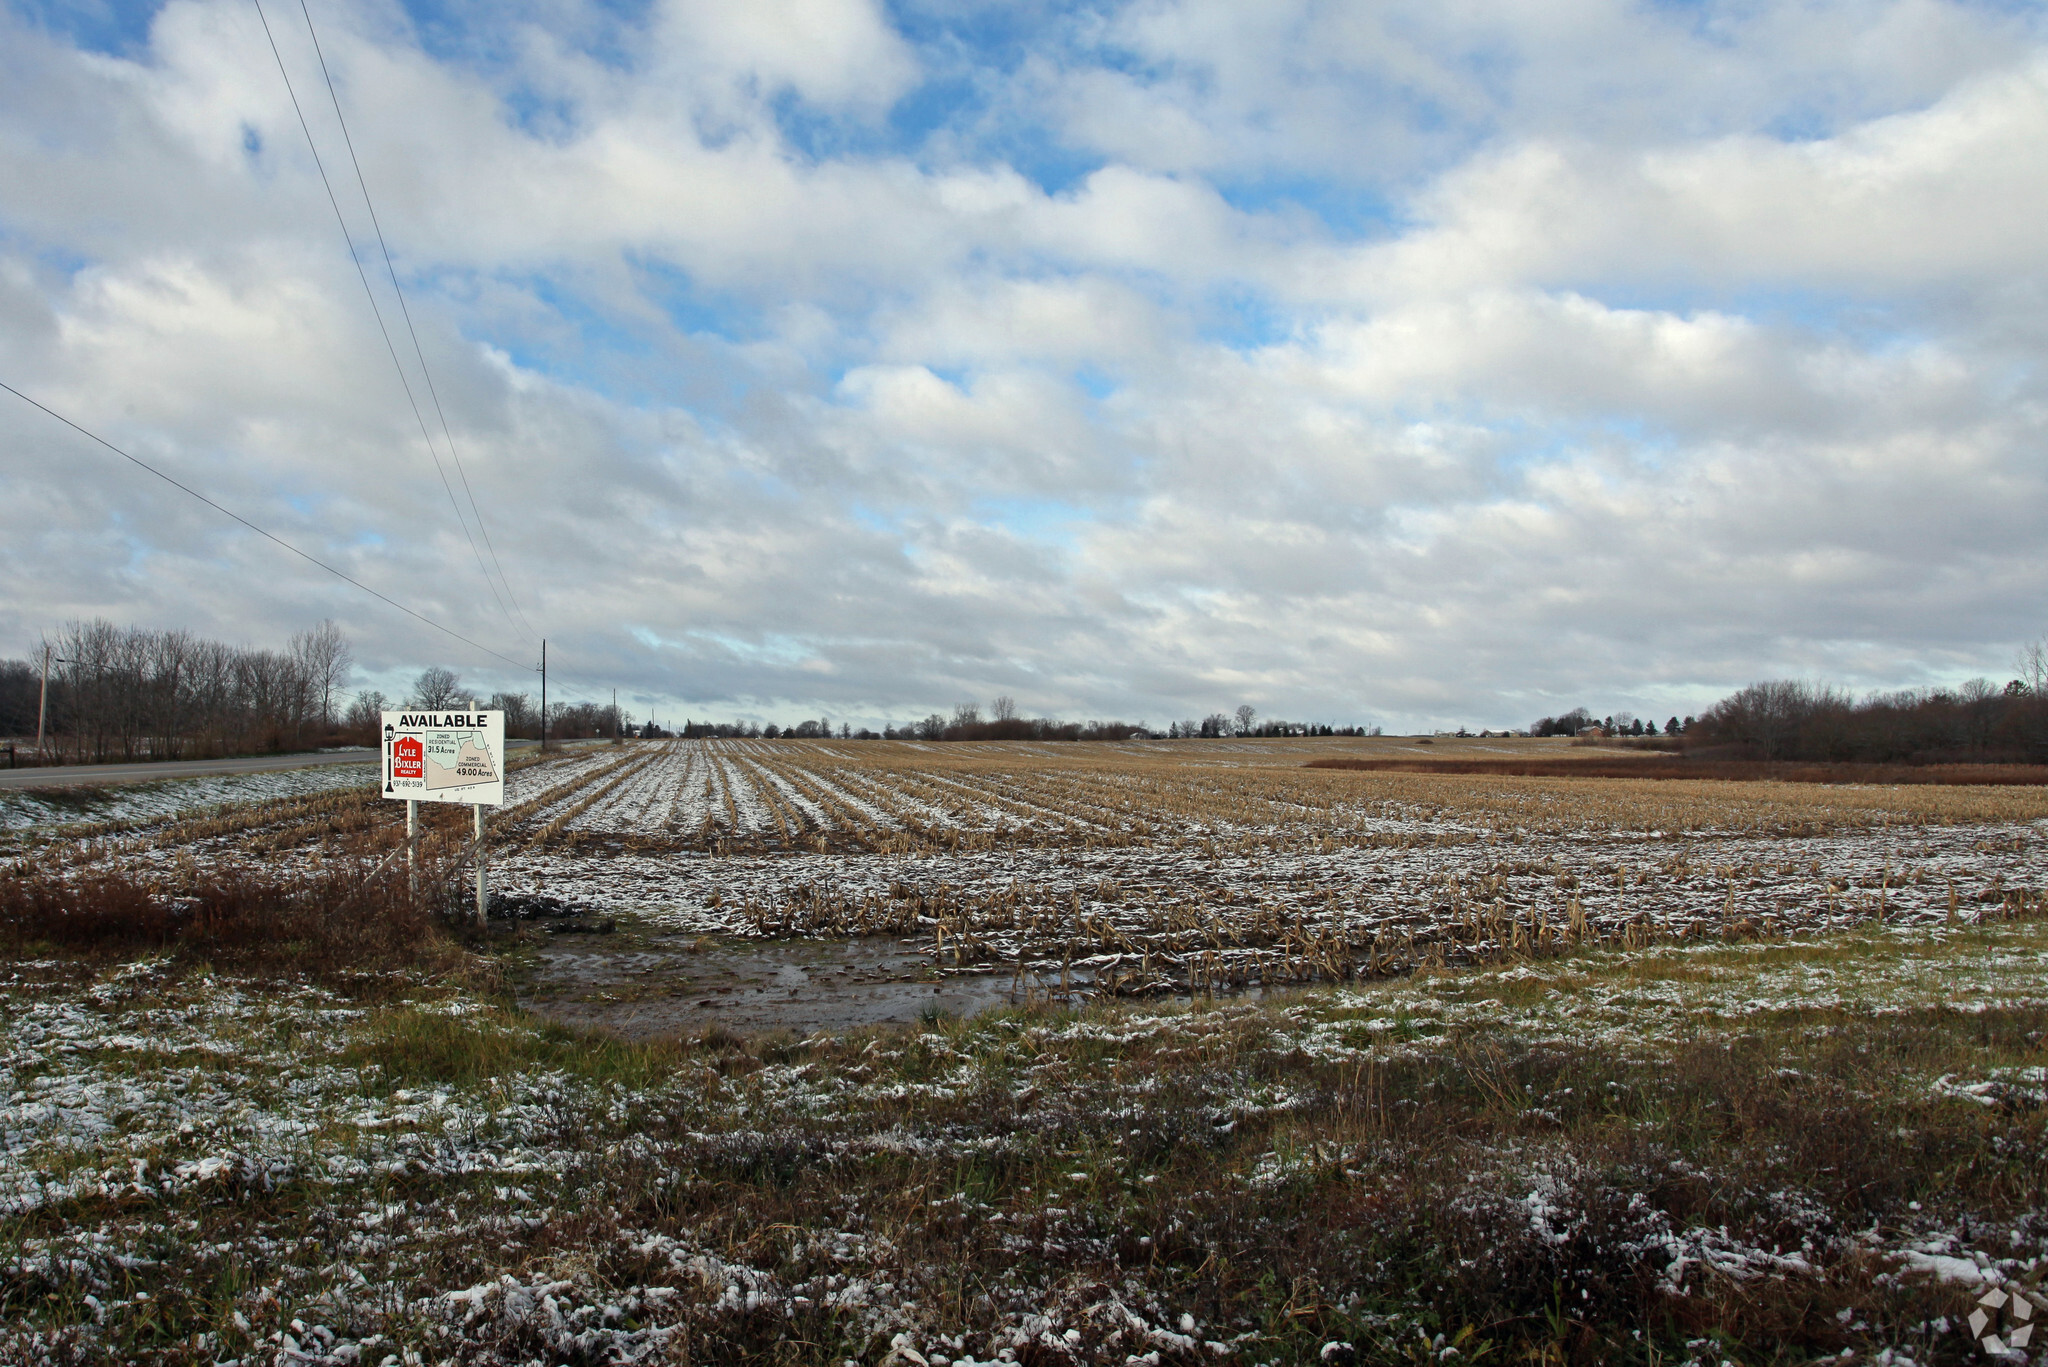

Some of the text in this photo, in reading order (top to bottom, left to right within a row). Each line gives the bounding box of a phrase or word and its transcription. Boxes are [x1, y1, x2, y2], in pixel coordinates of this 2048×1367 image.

[400, 715, 487, 727] AVAILABLE
[440, 746, 455, 754] Acres
[457, 768, 492, 777] 49.00 Acres
